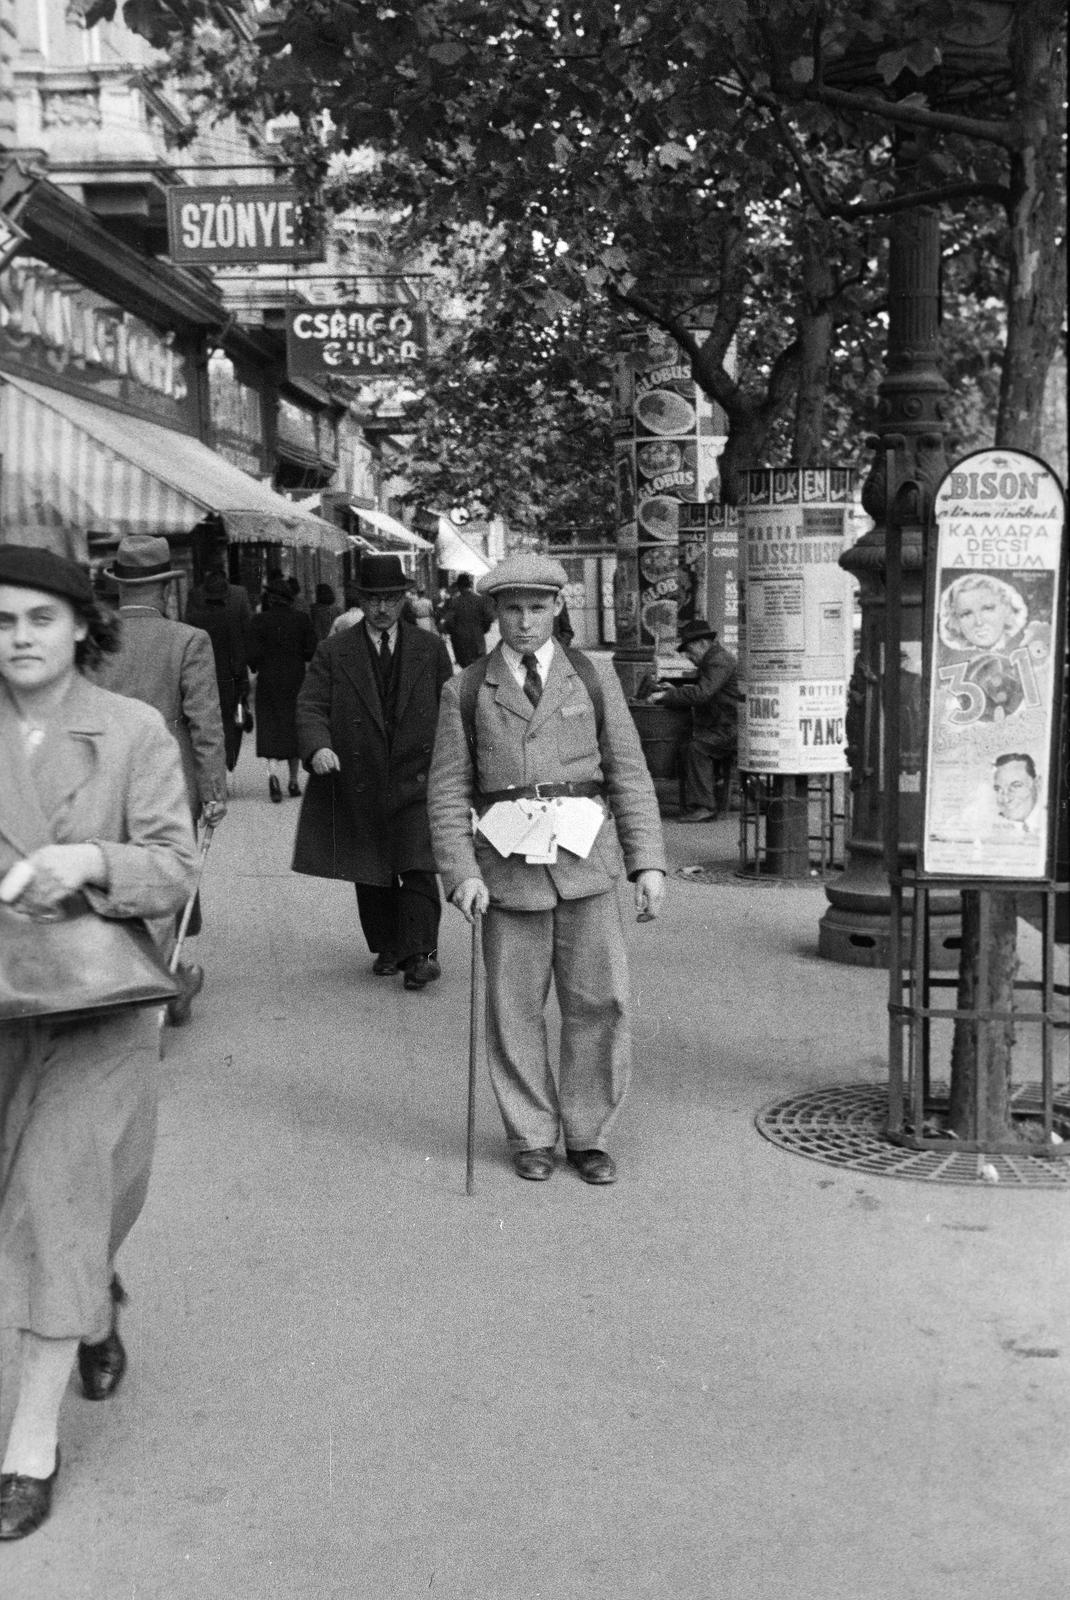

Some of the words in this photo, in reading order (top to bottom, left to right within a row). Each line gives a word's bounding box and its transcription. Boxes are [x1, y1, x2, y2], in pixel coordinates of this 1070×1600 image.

[181, 195, 304, 248] SZŐNYE
[635, 365, 692, 395] GLOBUS
[638, 471, 695, 500] GLOBUS
[949, 523, 1049, 538] KAMARA
